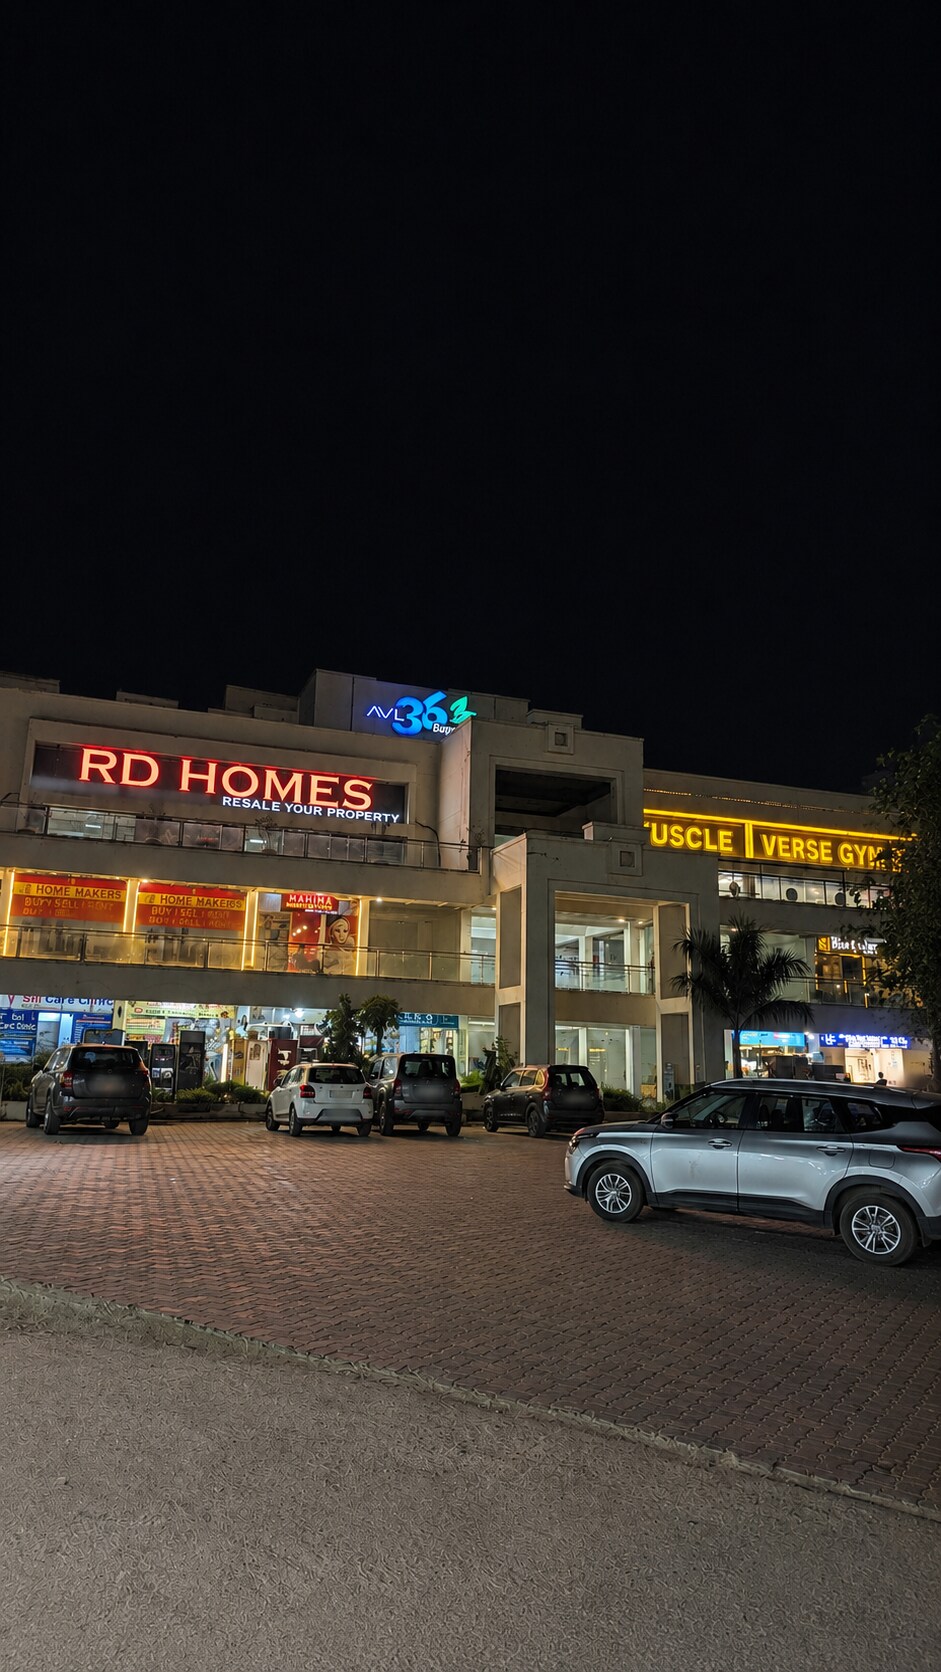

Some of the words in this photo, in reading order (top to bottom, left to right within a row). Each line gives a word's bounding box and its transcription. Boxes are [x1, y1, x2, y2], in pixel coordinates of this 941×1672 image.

[367, 705, 404, 721] AVL
[79, 747, 159, 787] RD
[179, 758, 373, 810] HOMES
[222, 796, 281, 812] RESALE
[284, 803, 323, 816] YOUR
[327, 807, 400, 823] PROPERTY
[644, 821, 734, 852] USCLE
[760, 833, 833, 862] VERSE
[36, 884, 71, 896] HOME
[75, 888, 122, 899] MAKERS
[160, 895, 192, 906] HOME
